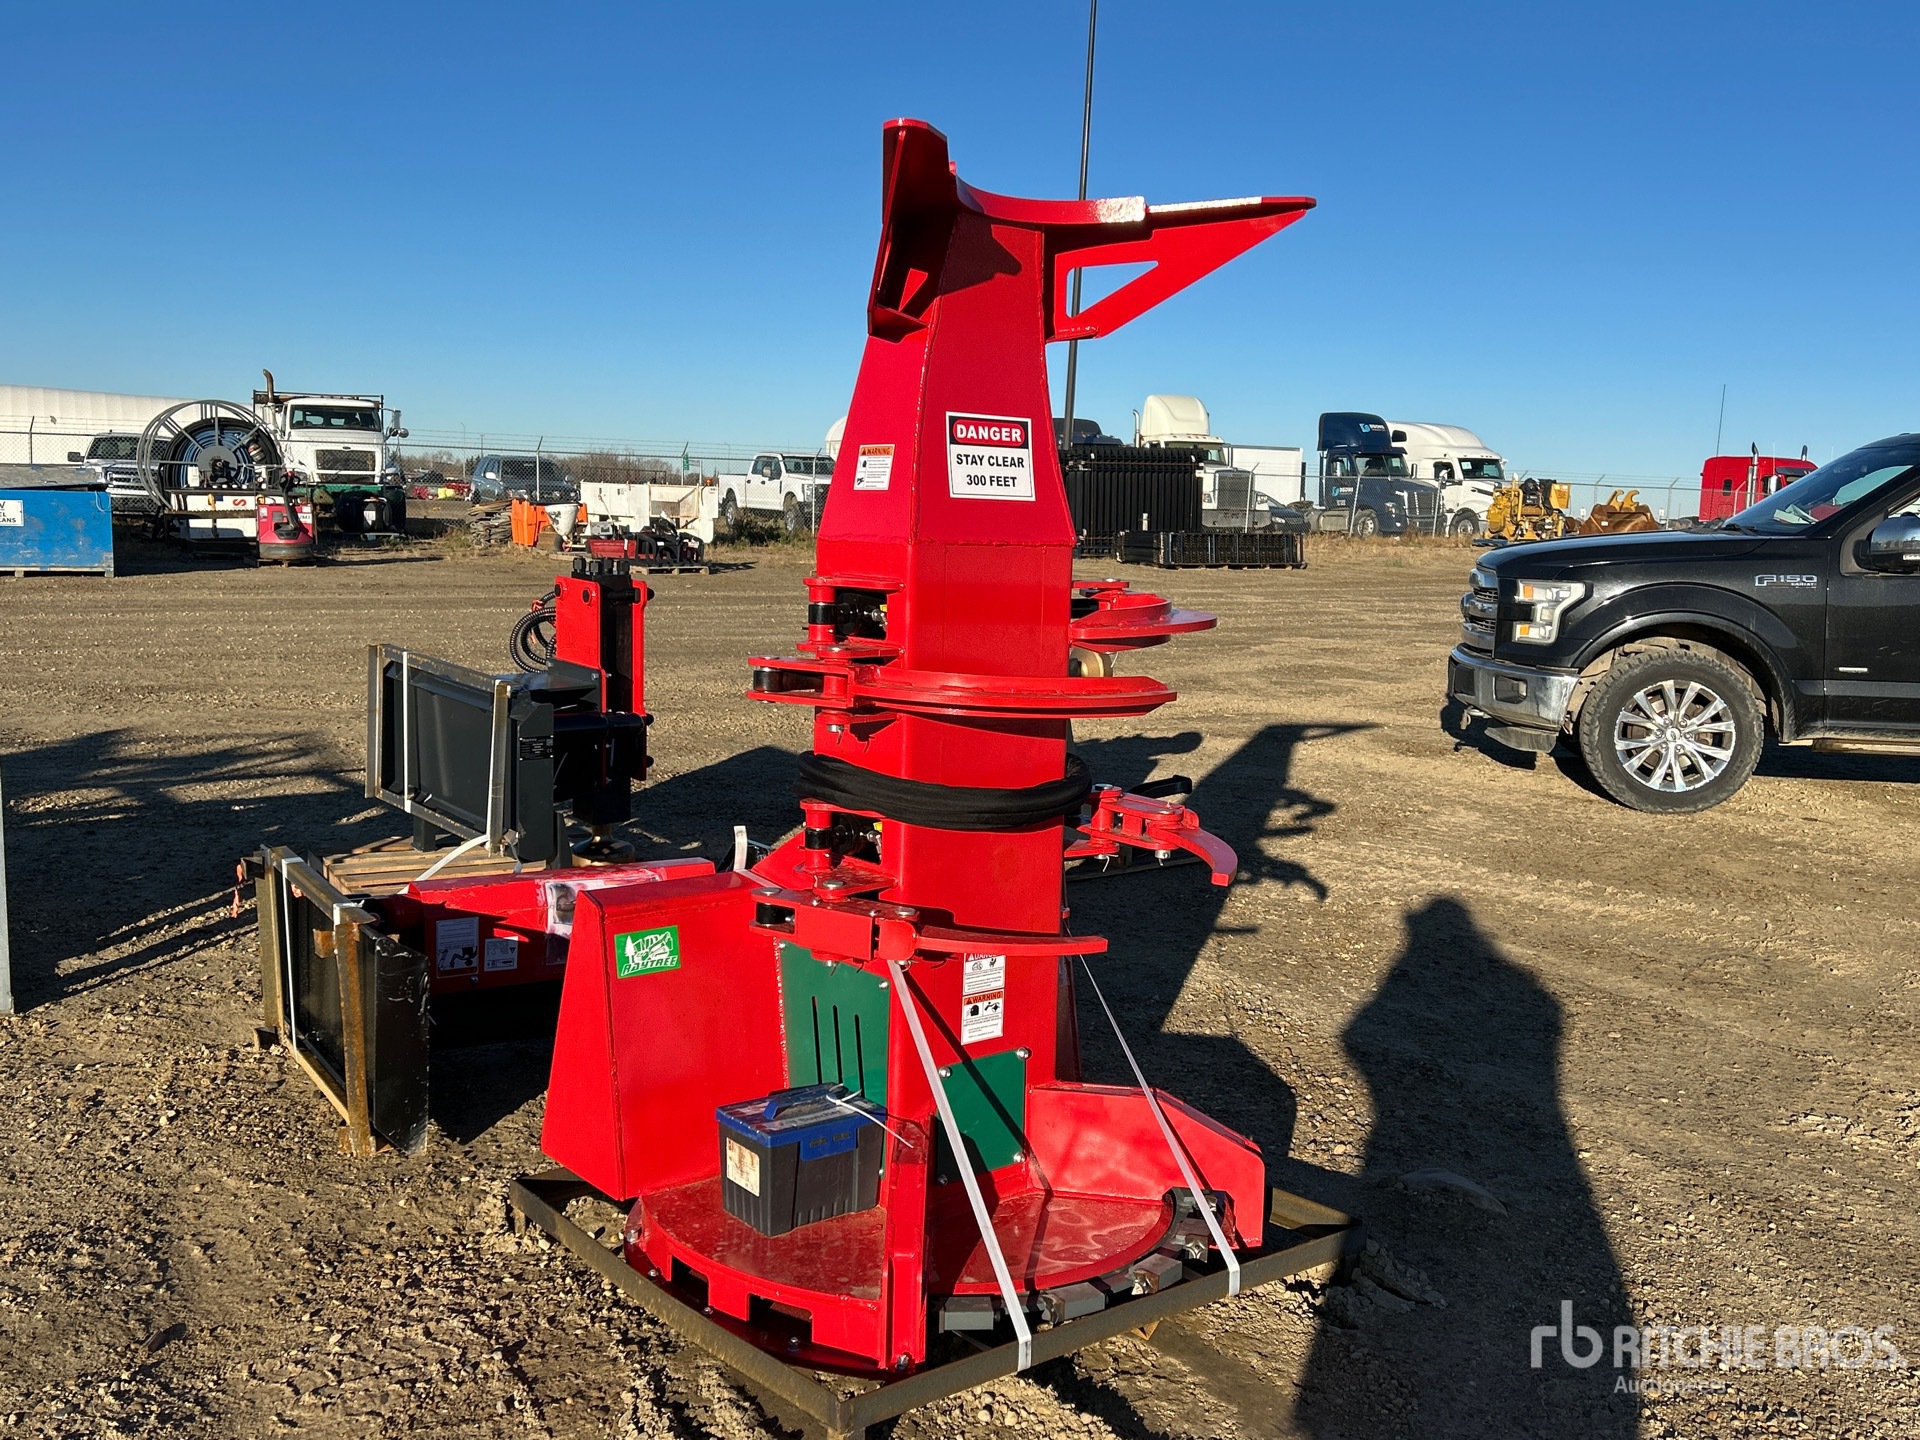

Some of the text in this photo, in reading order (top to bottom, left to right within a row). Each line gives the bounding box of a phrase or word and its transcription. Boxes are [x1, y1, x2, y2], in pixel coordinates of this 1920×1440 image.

[956, 424, 1022, 442] DANGER
[956, 453, 1025, 468] STAY CLEAR
[966, 474, 1017, 488] 300 FEET
[621, 955, 679, 977] RAYTREE
[972, 992, 1001, 1004] WARNING
